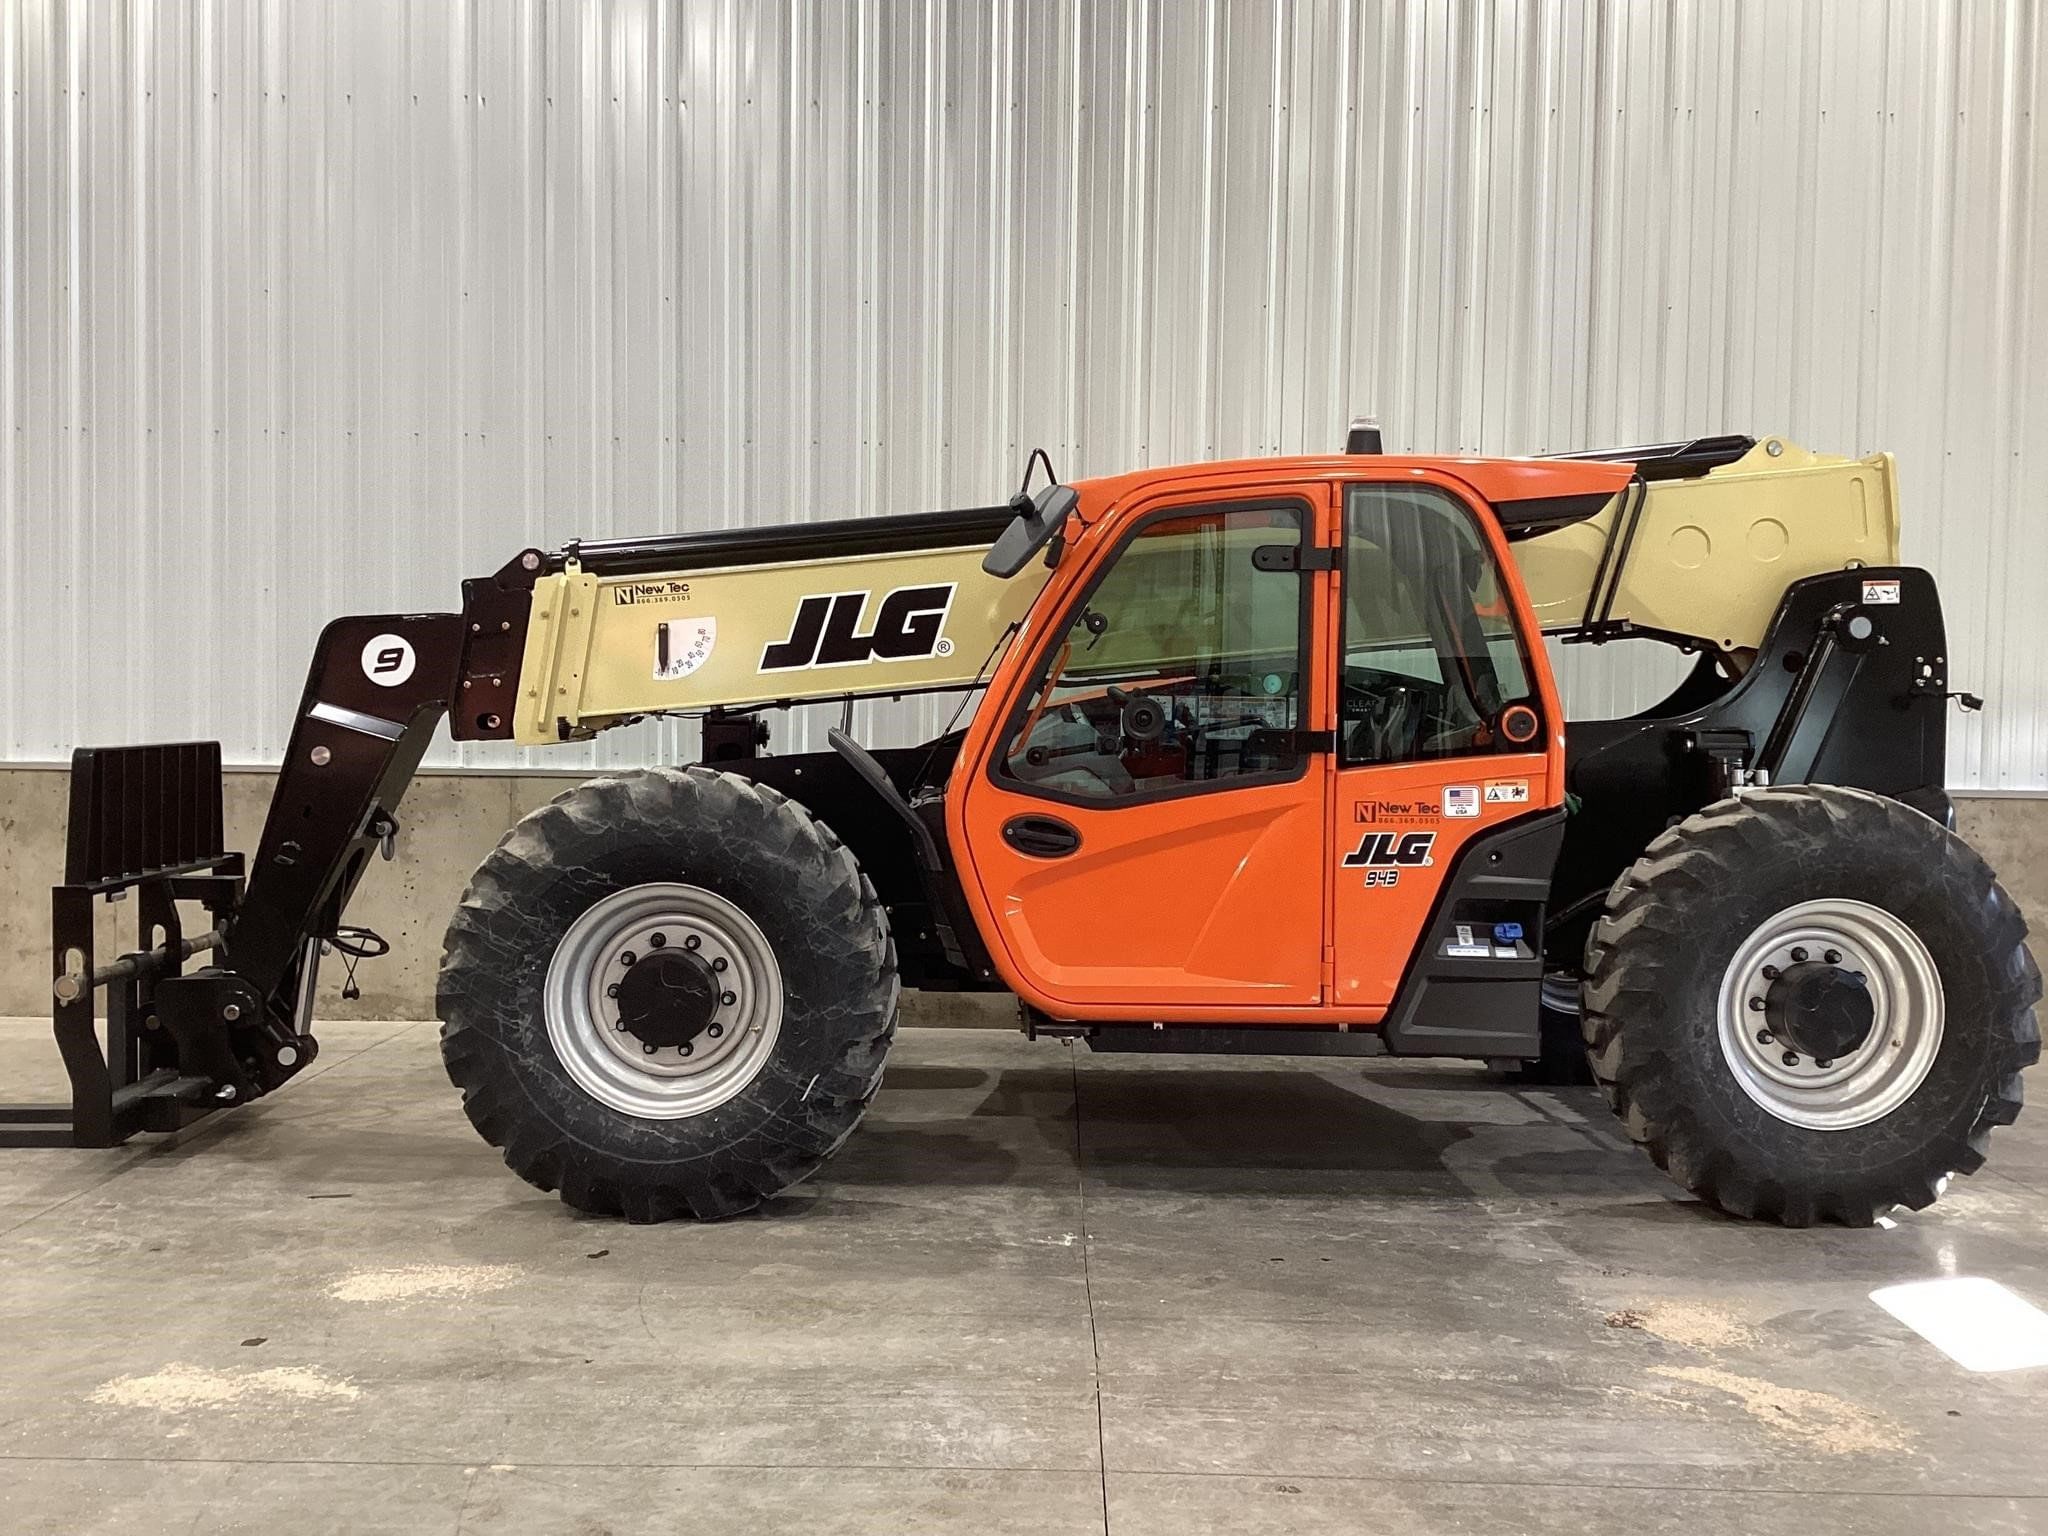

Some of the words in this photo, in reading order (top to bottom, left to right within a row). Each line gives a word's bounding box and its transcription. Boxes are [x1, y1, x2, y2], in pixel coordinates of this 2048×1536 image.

[635, 584, 664, 596] New
[666, 582, 690, 593] Tec
[759, 584, 955, 672] JLG
[373, 647, 405, 673] 9
[1378, 802, 1412, 813] New
[1414, 801, 1440, 814] Tec
[1342, 833, 1436, 867] JLG
[1365, 870, 1398, 886] 943
